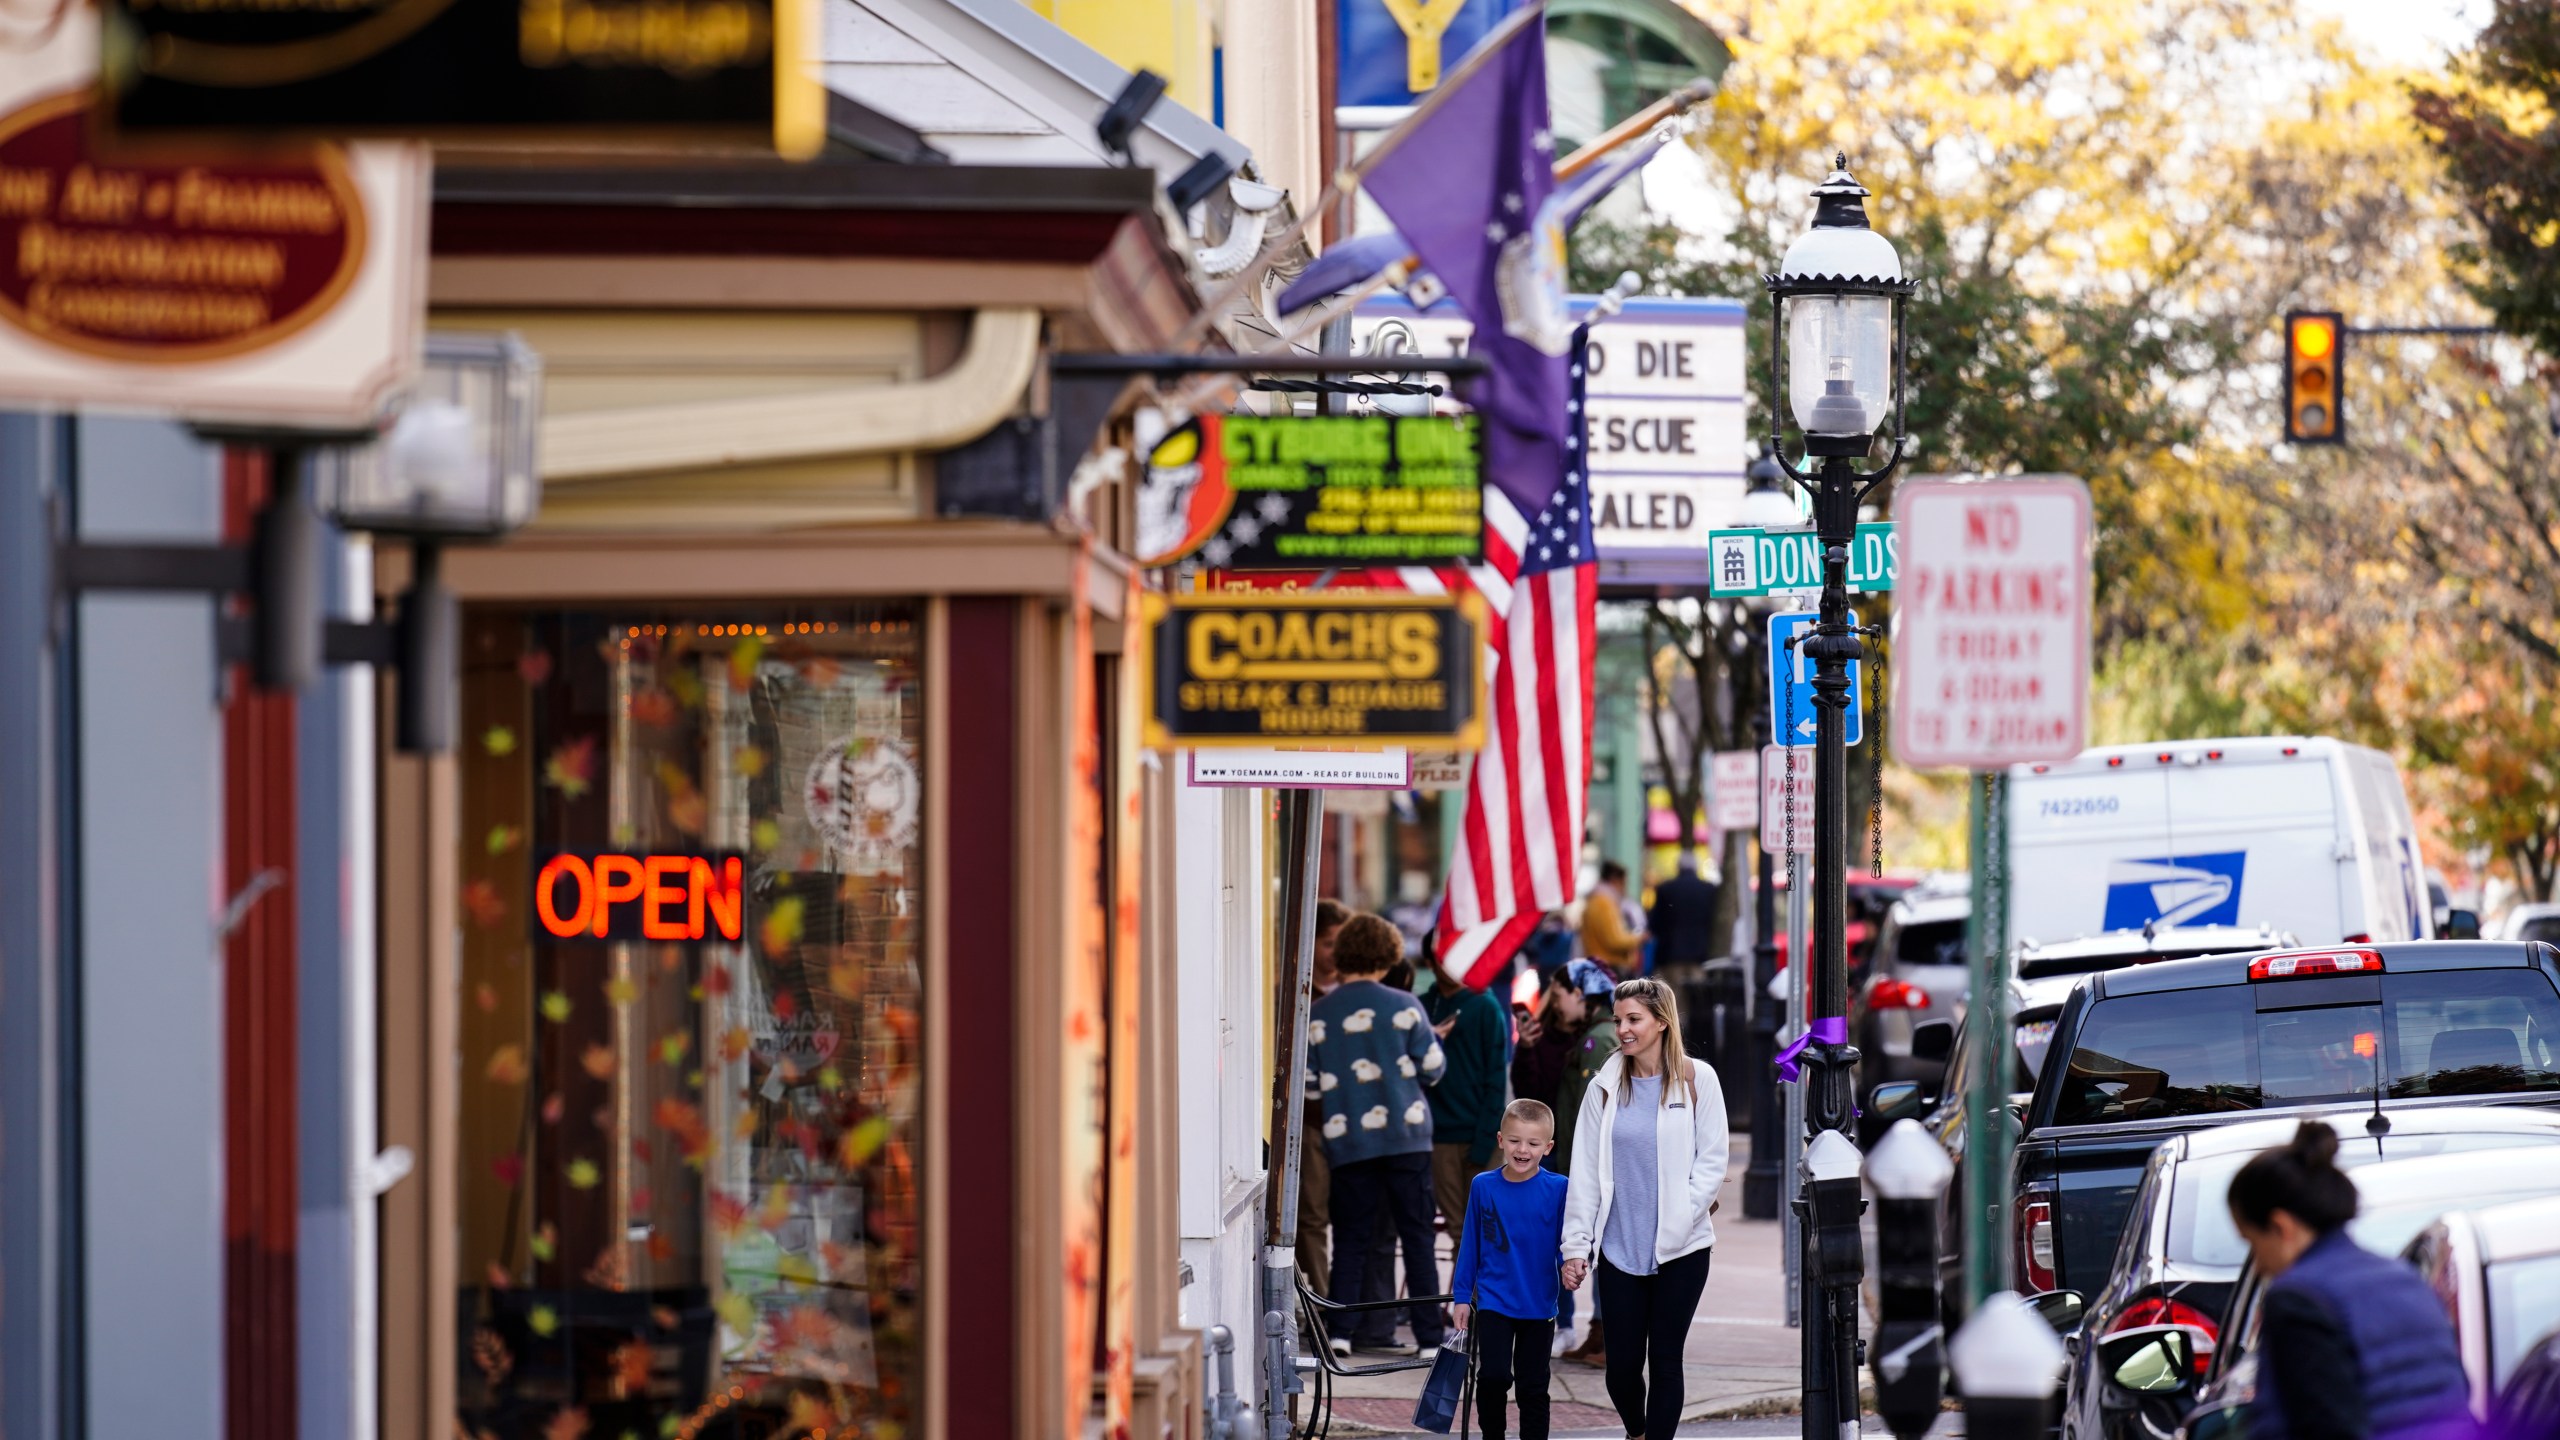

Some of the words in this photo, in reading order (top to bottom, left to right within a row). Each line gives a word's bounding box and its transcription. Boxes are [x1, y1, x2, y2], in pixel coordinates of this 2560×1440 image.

[1637, 341, 1693, 378] DIE
[1590, 492, 1694, 529] ALED
[1965, 501, 2021, 554] NO
[1914, 565, 2069, 617] PARKING
[1187, 610, 1440, 680] COACHS
[1939, 628, 2043, 662] FRIDAY
[1179, 681, 1290, 710] STEAK
[1327, 681, 1447, 710] HOAGIE
[1260, 709, 1367, 734] HOUSE
[1914, 711, 1947, 744] TO
[1202, 769, 1303, 777] WWW.YOEMAMA.COM
[1314, 770, 1339, 778] REAR
[1356, 771, 1400, 780] BUILDING
[535, 854, 742, 940] OPEN
